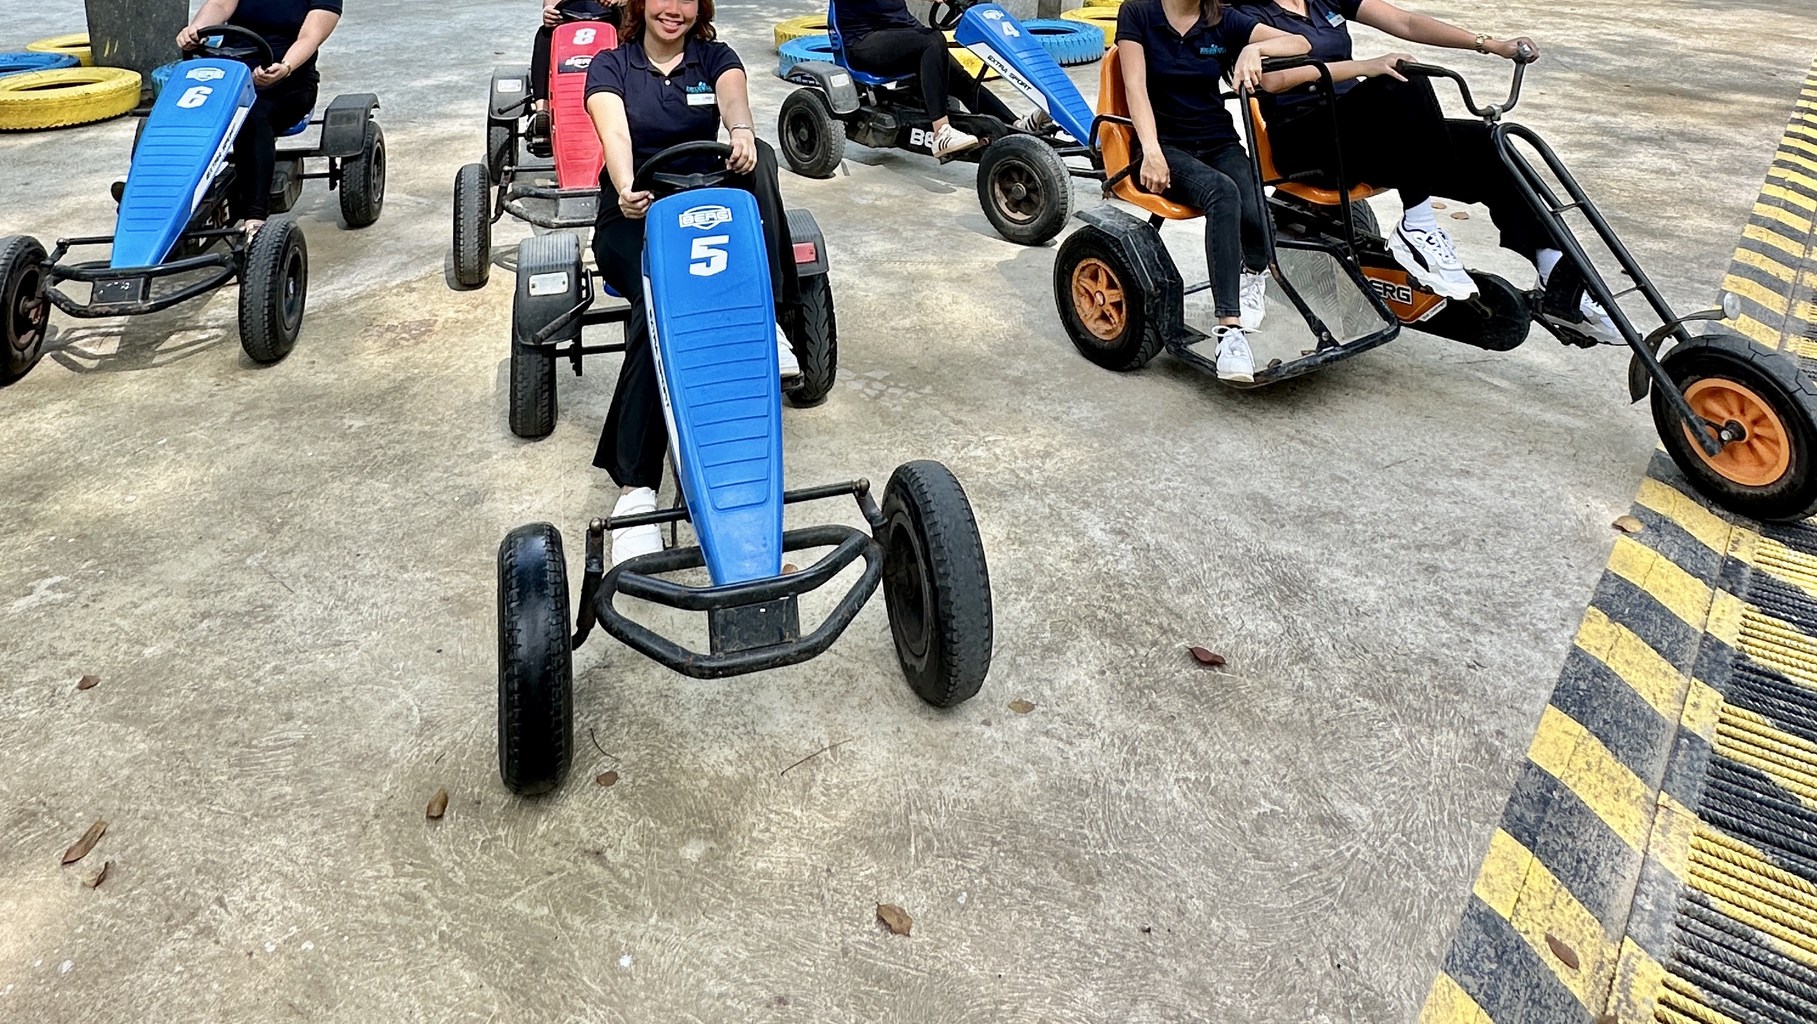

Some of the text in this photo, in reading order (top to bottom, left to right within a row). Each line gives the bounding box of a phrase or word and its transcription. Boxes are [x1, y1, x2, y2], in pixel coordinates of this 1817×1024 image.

[572, 27, 597, 45] 8
[1001, 21, 1021, 38] 4
[987, 55, 1032, 91] EXTRA SPORT
[176, 86, 213, 108] 6
[910, 128, 935, 148] BE
[682, 211, 730, 225] BERG
[689, 235, 729, 276] 5
[1368, 279, 1412, 305] ERG
